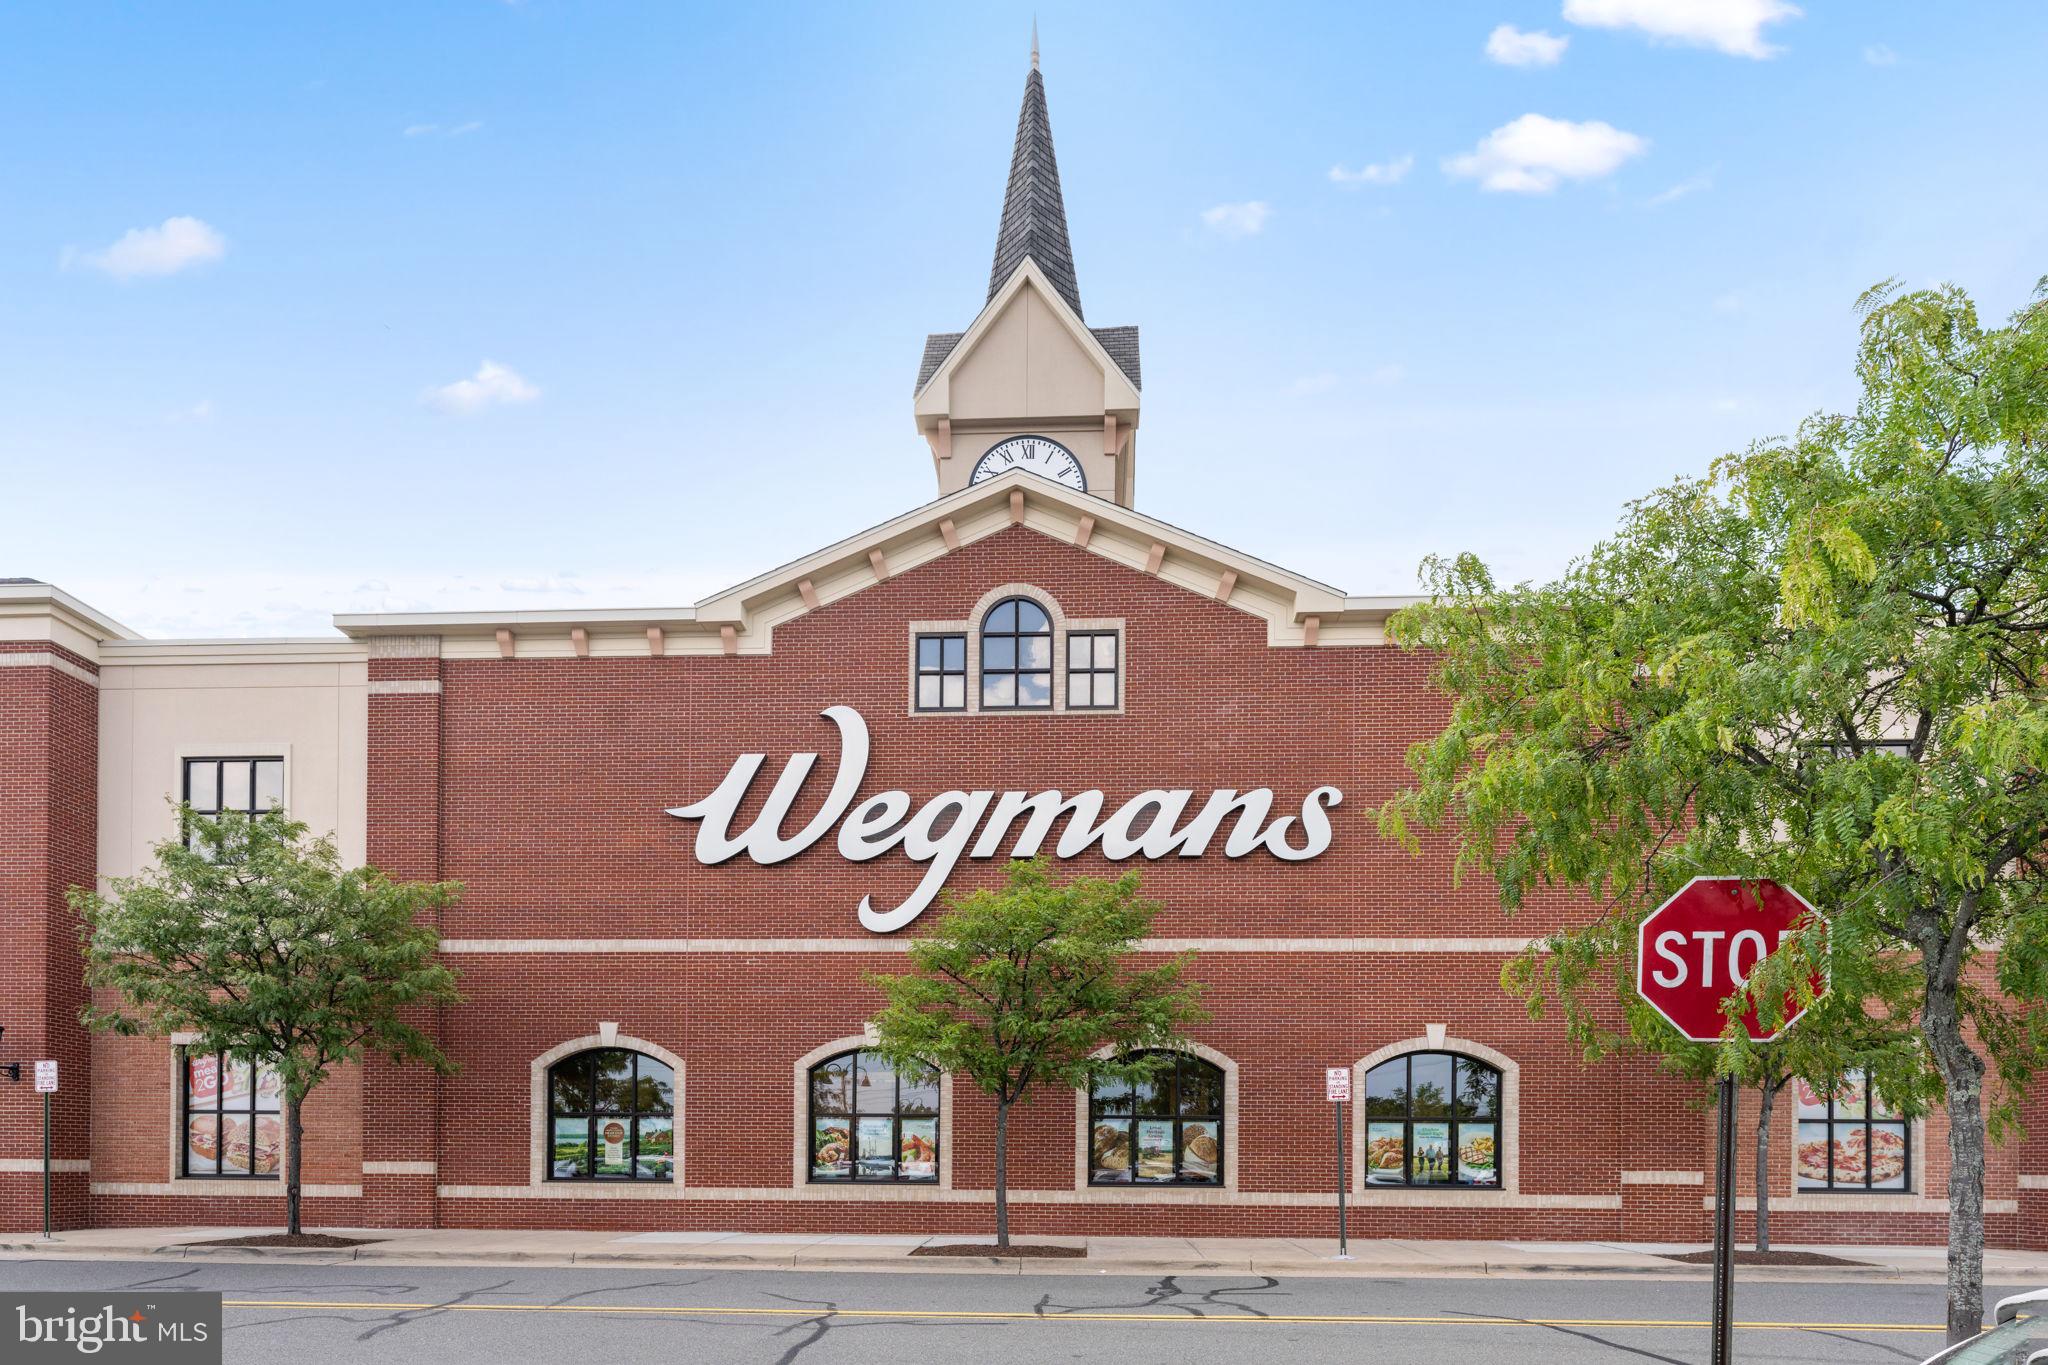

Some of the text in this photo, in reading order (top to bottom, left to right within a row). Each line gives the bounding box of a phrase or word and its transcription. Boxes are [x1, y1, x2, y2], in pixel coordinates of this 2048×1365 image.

[999, 448, 1015, 466] XI
[1021, 444, 1035, 460] XII
[664, 704, 1344, 933] Wegmans
[193, 1065, 218, 1079] mea
